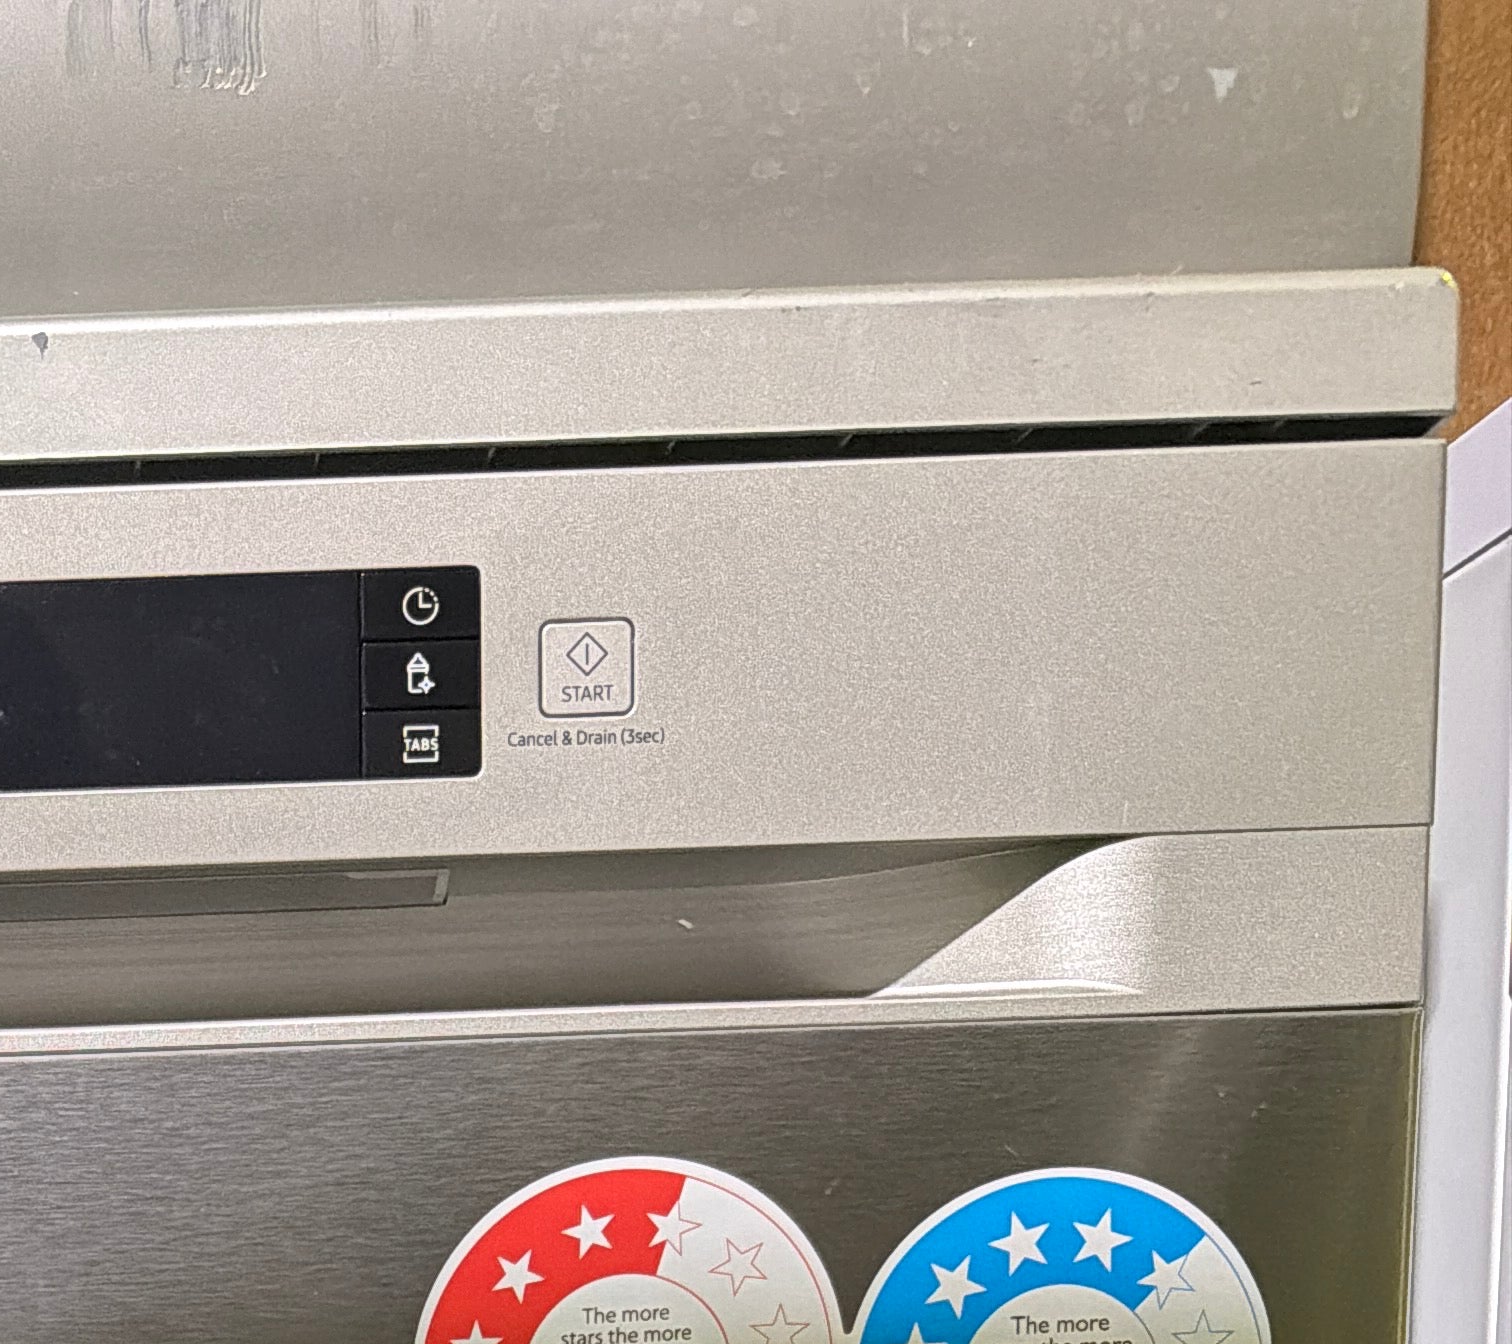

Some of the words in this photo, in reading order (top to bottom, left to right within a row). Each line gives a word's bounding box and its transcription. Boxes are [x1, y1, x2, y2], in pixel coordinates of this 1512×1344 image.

[561, 684, 614, 703] START
[404, 737, 439, 751] TABS
[508, 732, 557, 748] Cancel
[562, 732, 573, 746] &
[576, 730, 617, 746] Drain
[620, 728, 665, 746] (3sec)
[582, 1307, 616, 1325] The
[622, 1307, 670, 1322] more
[1010, 1315, 1050, 1335] The
[1056, 1317, 1110, 1333] more
[608, 1327, 638, 1344] the
[643, 1327, 692, 1342] more
